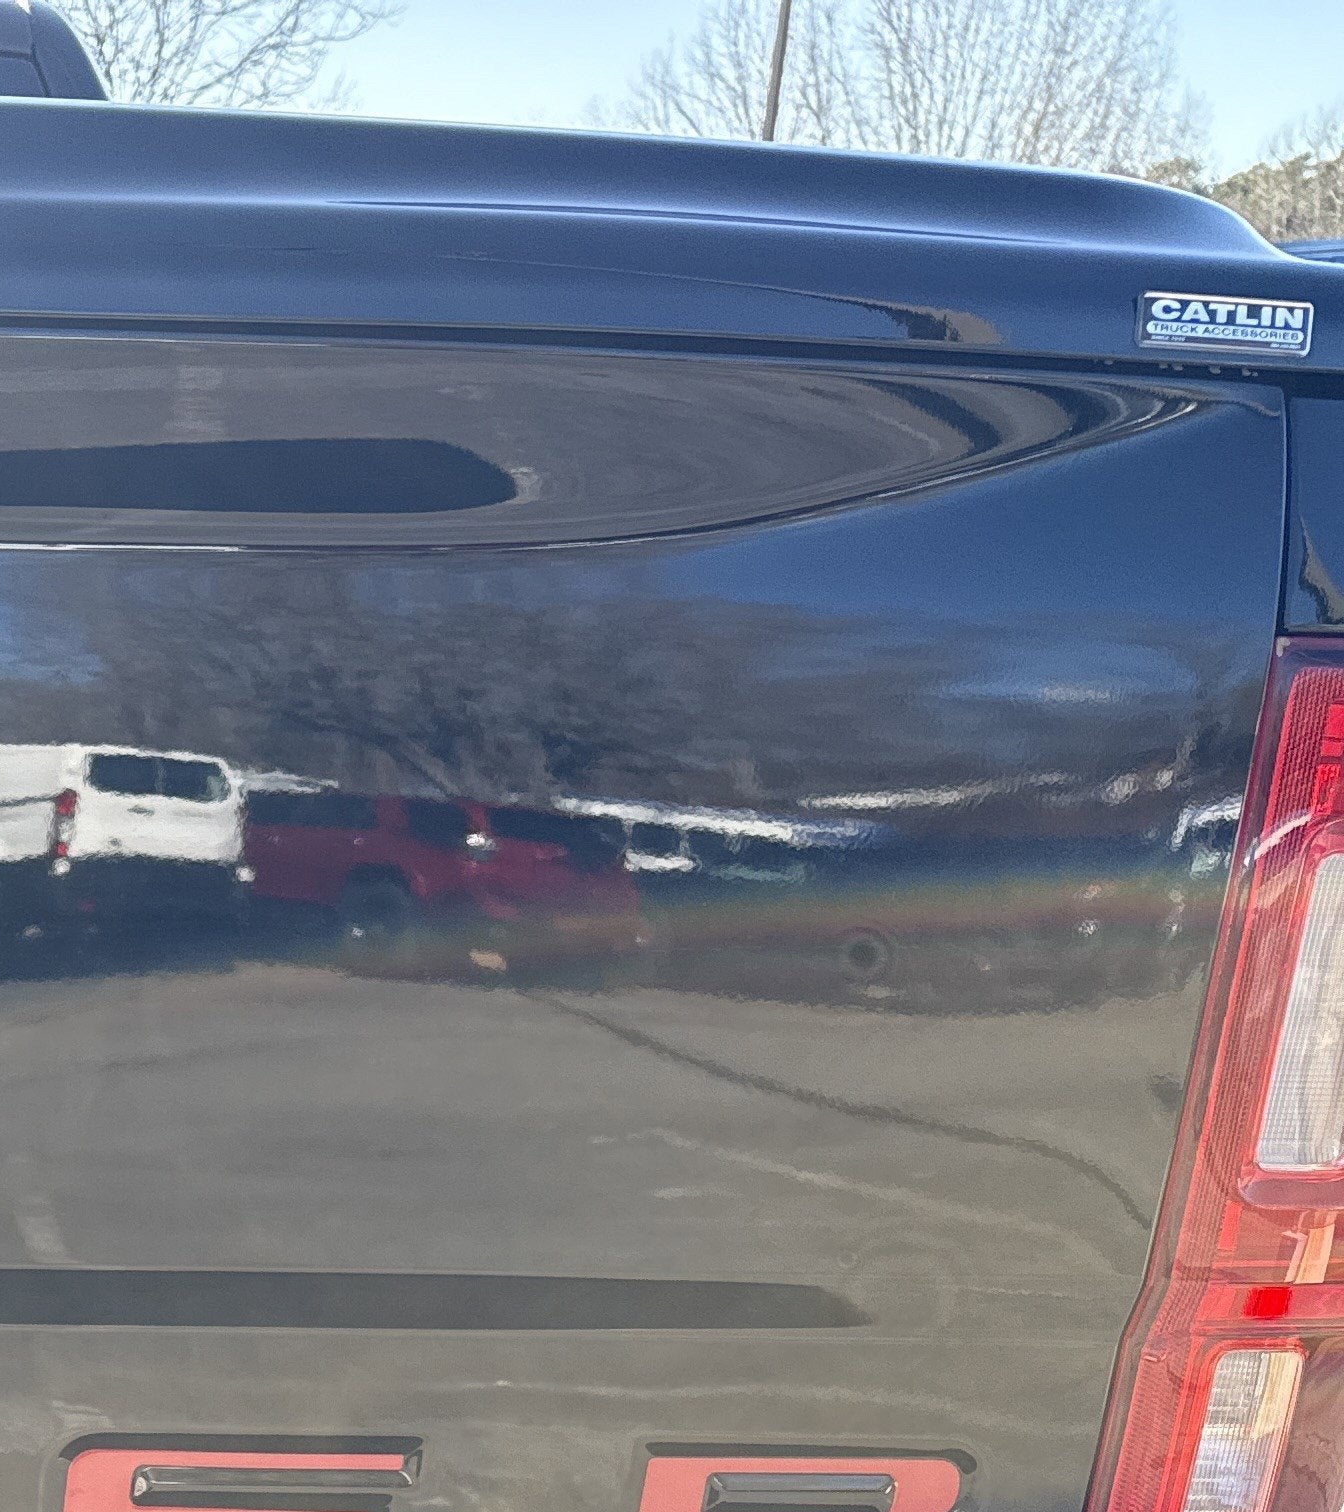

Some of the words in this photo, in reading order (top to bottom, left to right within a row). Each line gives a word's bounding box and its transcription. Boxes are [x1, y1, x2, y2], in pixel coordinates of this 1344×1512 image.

[1151, 299, 1304, 329] CATLIN
[1151, 322, 1199, 335] TRUCK
[1201, 326, 1300, 342] ACCESSORIES
